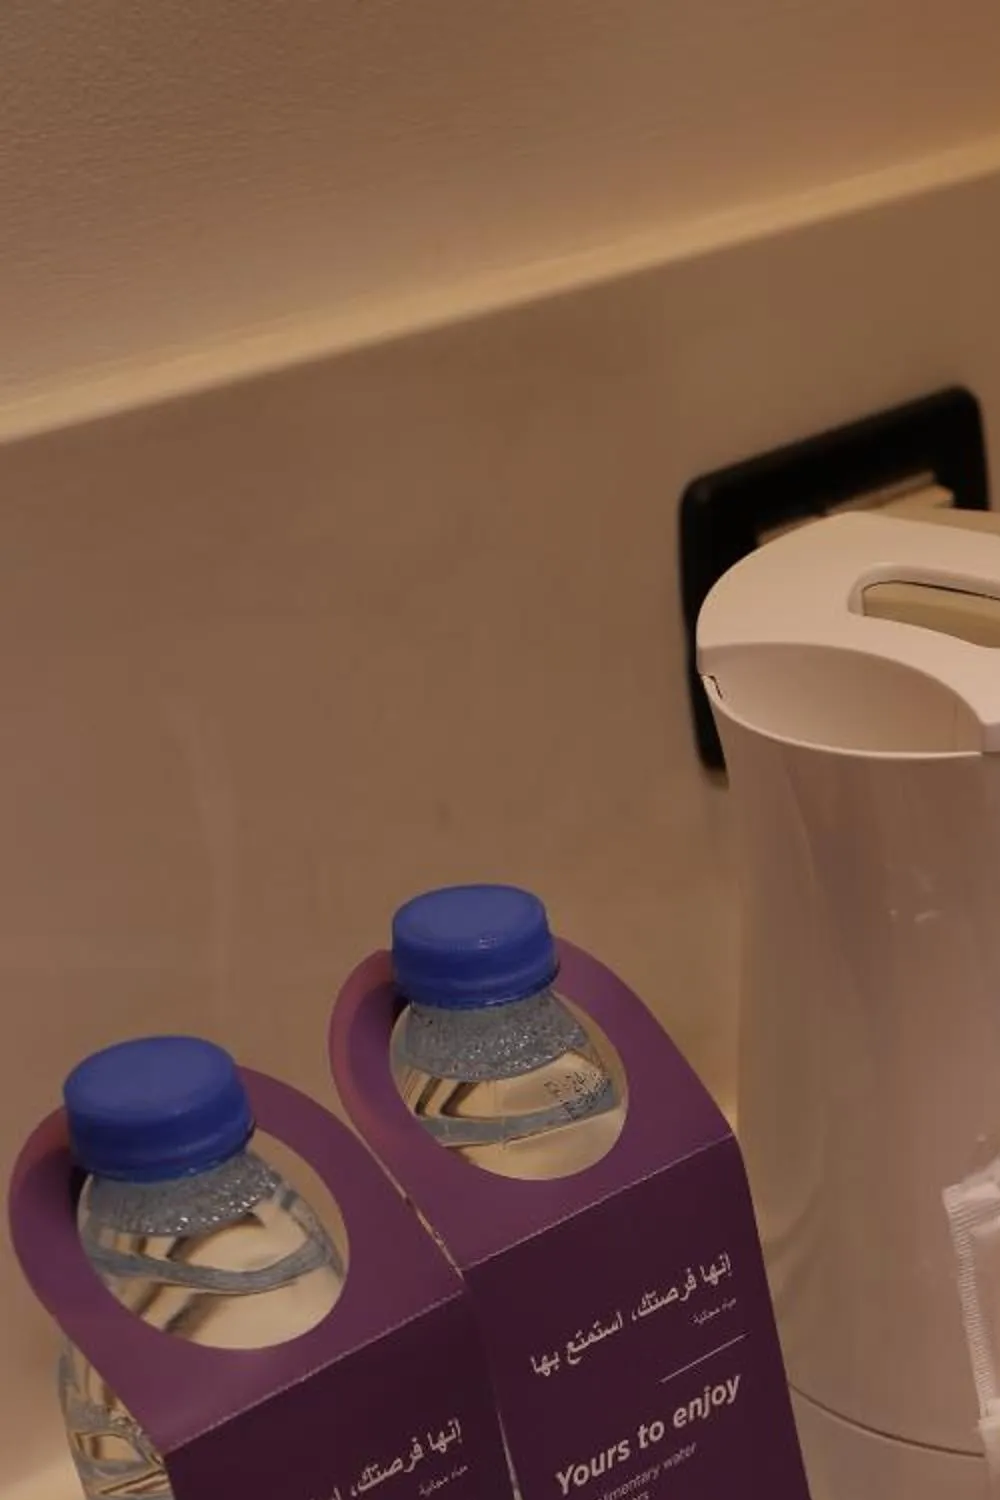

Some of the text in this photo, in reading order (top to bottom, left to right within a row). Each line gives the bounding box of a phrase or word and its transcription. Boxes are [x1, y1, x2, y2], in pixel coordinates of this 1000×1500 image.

[564, 1309, 623, 1364] استمتع
[529, 1351, 561, 1377] بها
[556, 1374, 741, 1495] Yours to enjoy
[663, 1442, 697, 1470] water
